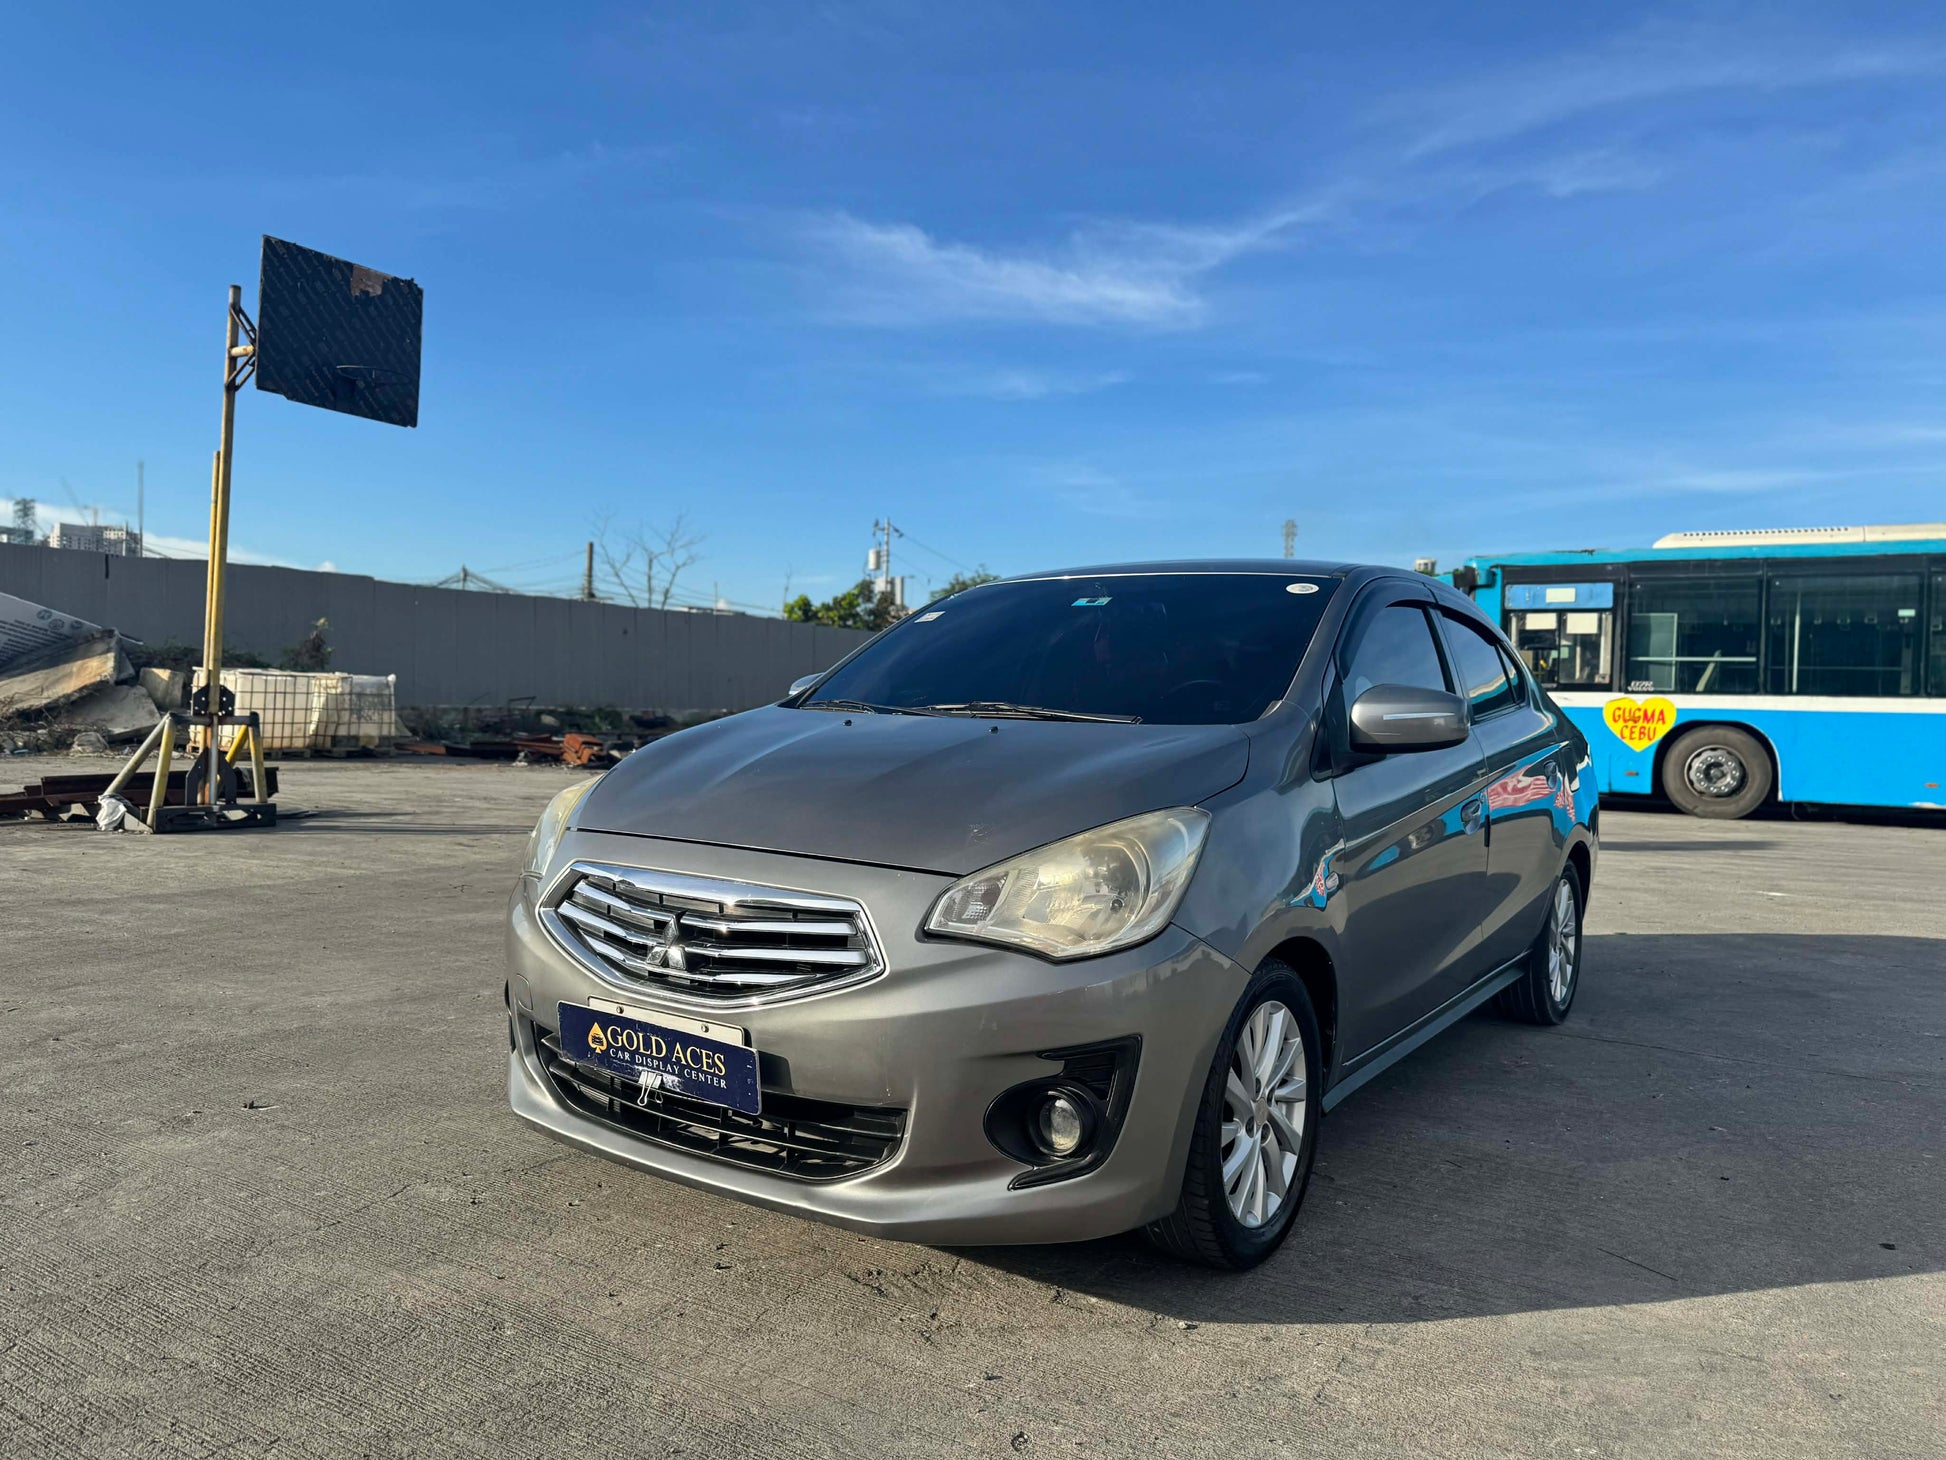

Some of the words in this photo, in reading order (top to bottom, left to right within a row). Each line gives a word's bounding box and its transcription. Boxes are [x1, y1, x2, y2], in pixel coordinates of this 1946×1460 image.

[1612, 707, 1666, 725] GUGMA
[1620, 725, 1656, 742] CEBU
[607, 1025, 667, 1058] GOLD
[671, 1041, 726, 1076] ACES
[609, 1048, 631, 1061] CAR
[635, 1054, 680, 1074] DISPLAY
[684, 1068, 727, 1089] CENTER
